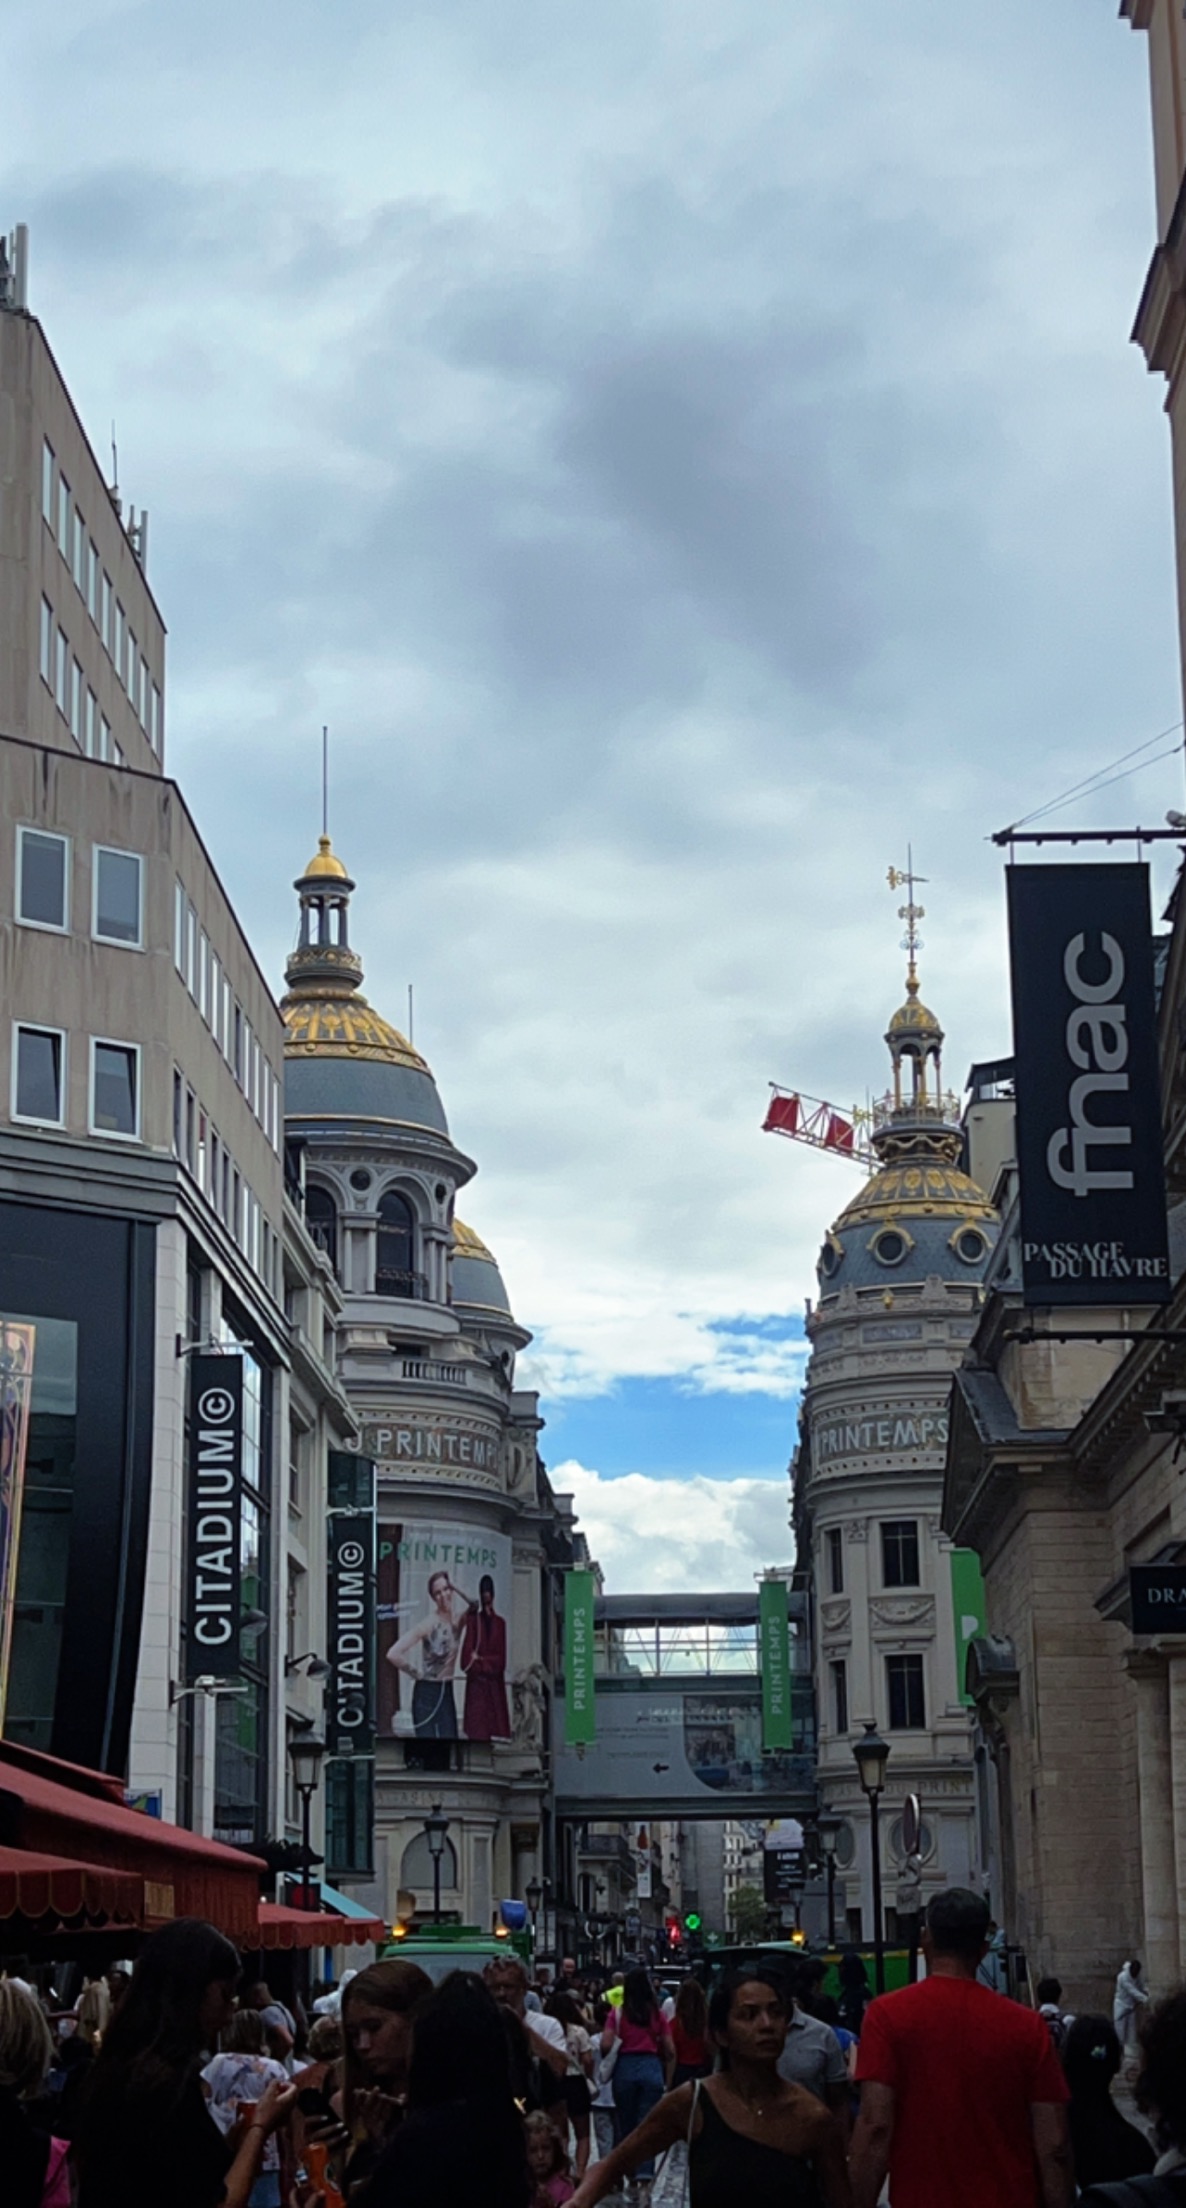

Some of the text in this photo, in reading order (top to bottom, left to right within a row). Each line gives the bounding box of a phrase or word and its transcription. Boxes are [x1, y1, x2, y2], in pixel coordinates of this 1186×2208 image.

[1046, 931, 1134, 1197] fnac
[1023, 1241, 1124, 1262] PASSAGE
[1050, 1256, 1167, 1278] DU HAVRE
[821, 1419, 949, 1457] PRINTEMPS
[379, 1542, 497, 1569] PRINTEMPS
[573, 1607, 585, 1711] PRINTEMPS
[768, 1615, 783, 1715] PRINTEMPS
